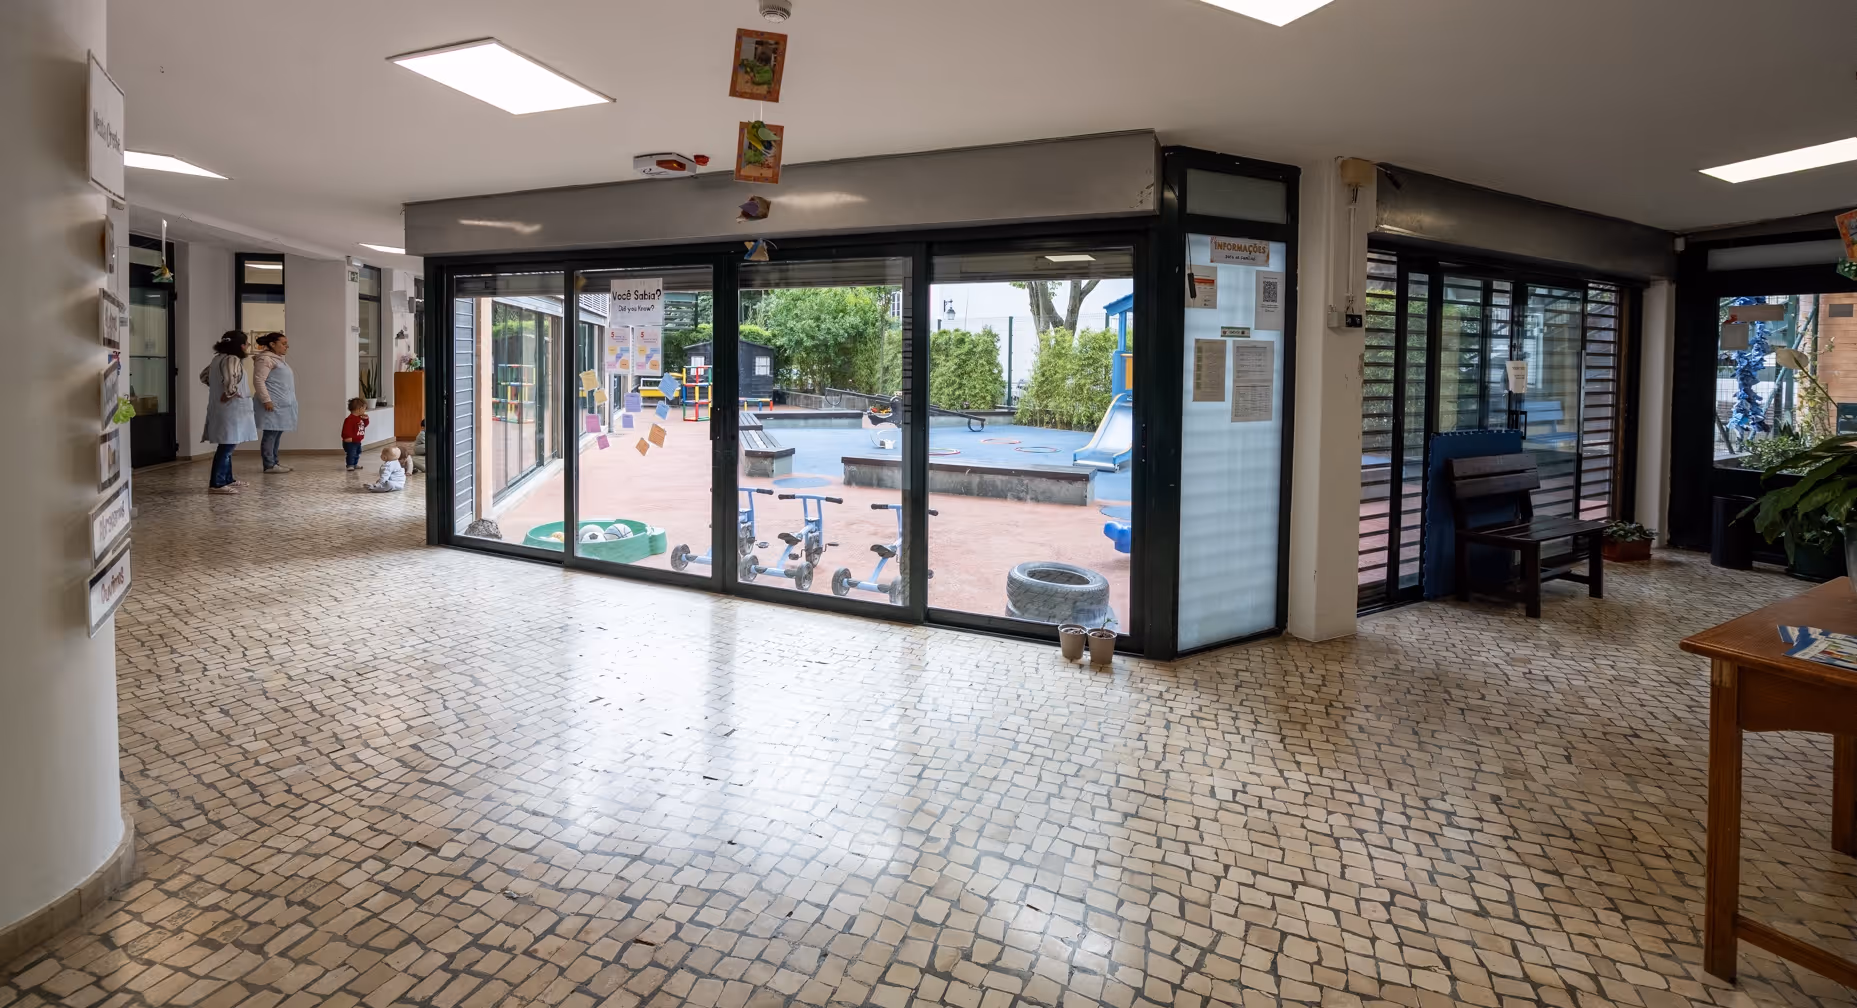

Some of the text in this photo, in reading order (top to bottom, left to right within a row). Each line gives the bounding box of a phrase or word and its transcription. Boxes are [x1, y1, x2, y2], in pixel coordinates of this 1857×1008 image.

[1214, 241, 1266, 255] INFORMAÇÕES
[612, 289, 662, 301] Você Sabia?
[618, 304, 627, 312] Did
[637, 304, 655, 312] Know?
